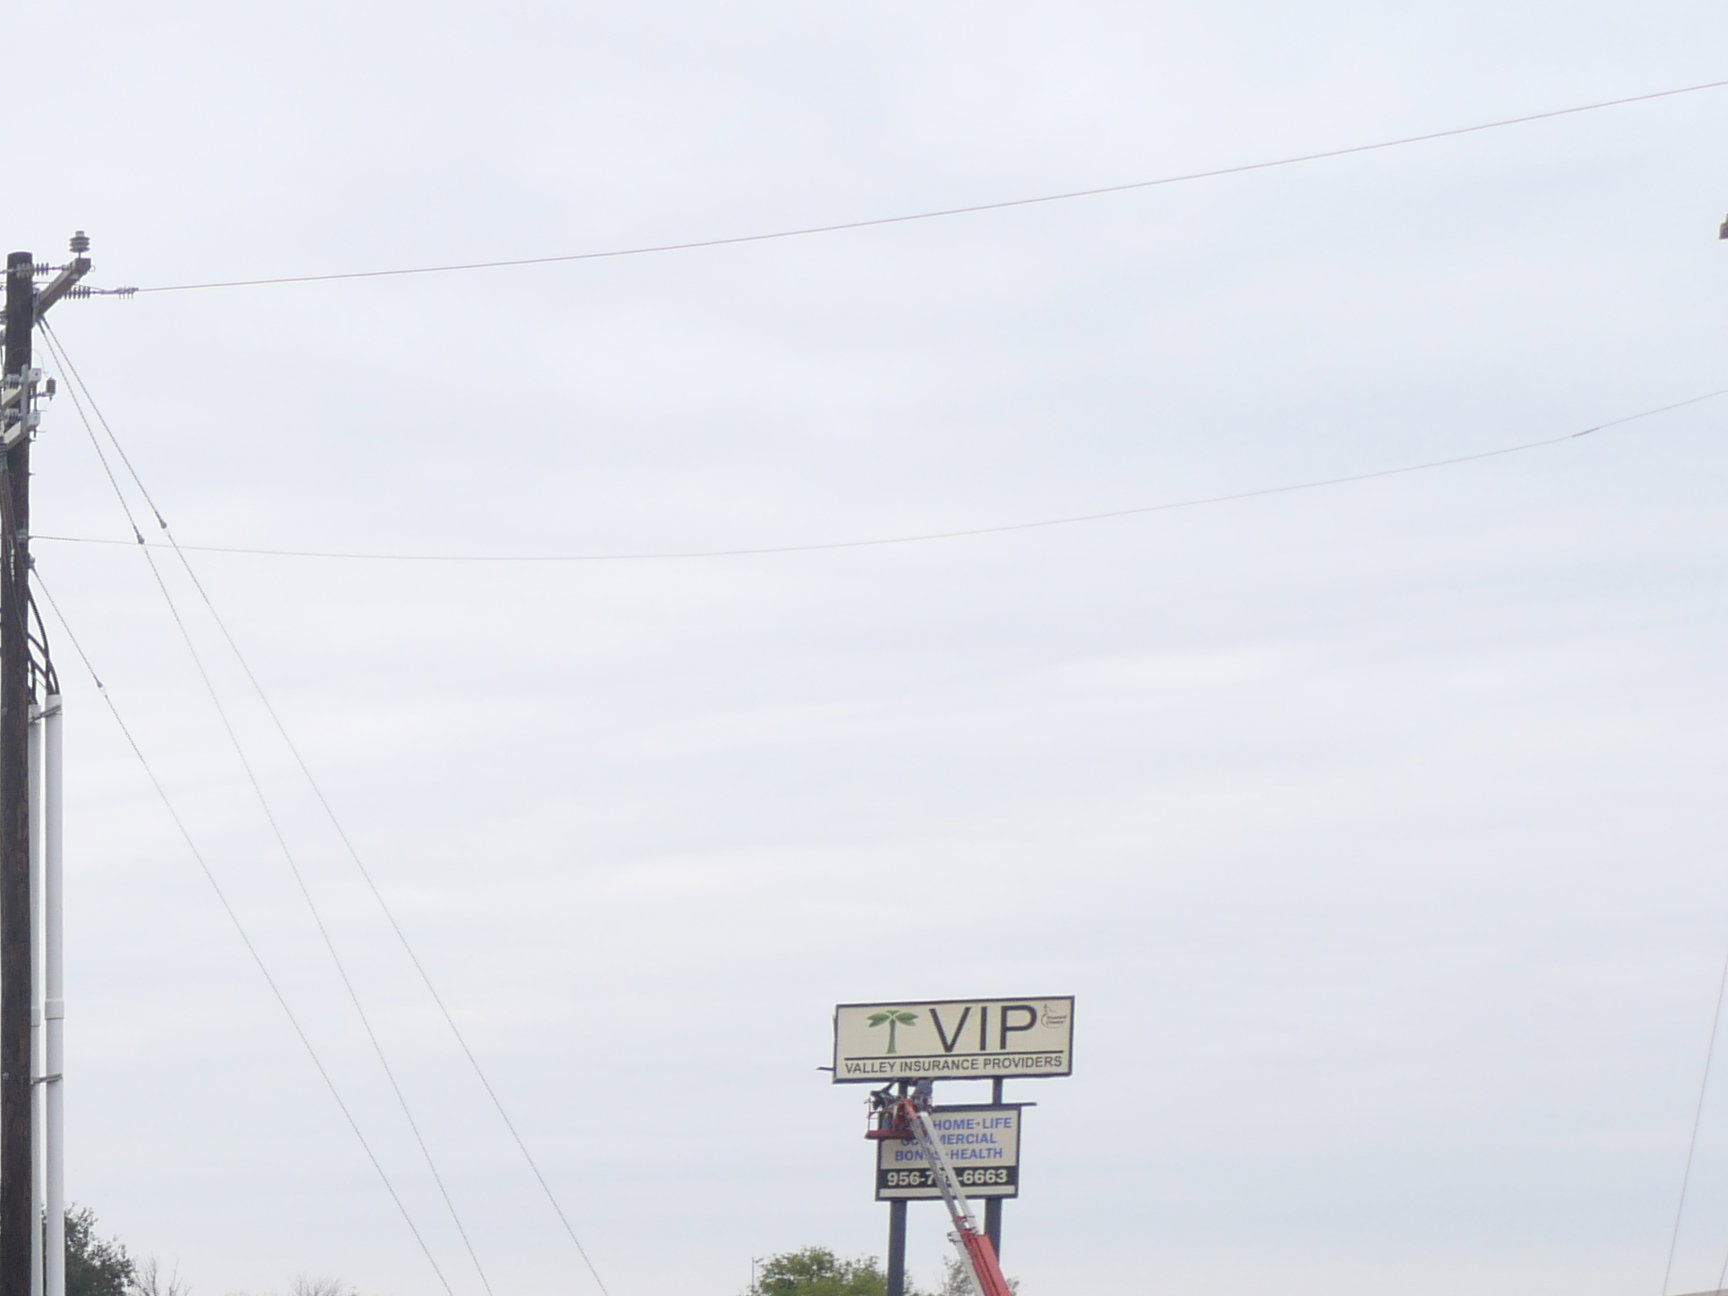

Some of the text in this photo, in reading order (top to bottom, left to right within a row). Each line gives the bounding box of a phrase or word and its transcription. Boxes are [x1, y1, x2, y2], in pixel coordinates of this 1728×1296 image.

[929, 1004, 1037, 1053] VIP
[845, 1055, 1063, 1074] VALLEY INSURANCE PROVIDERS
[950, 1148, 1003, 1160] HEALTH
[887, 1169, 1008, 1186] 956-7-6663
